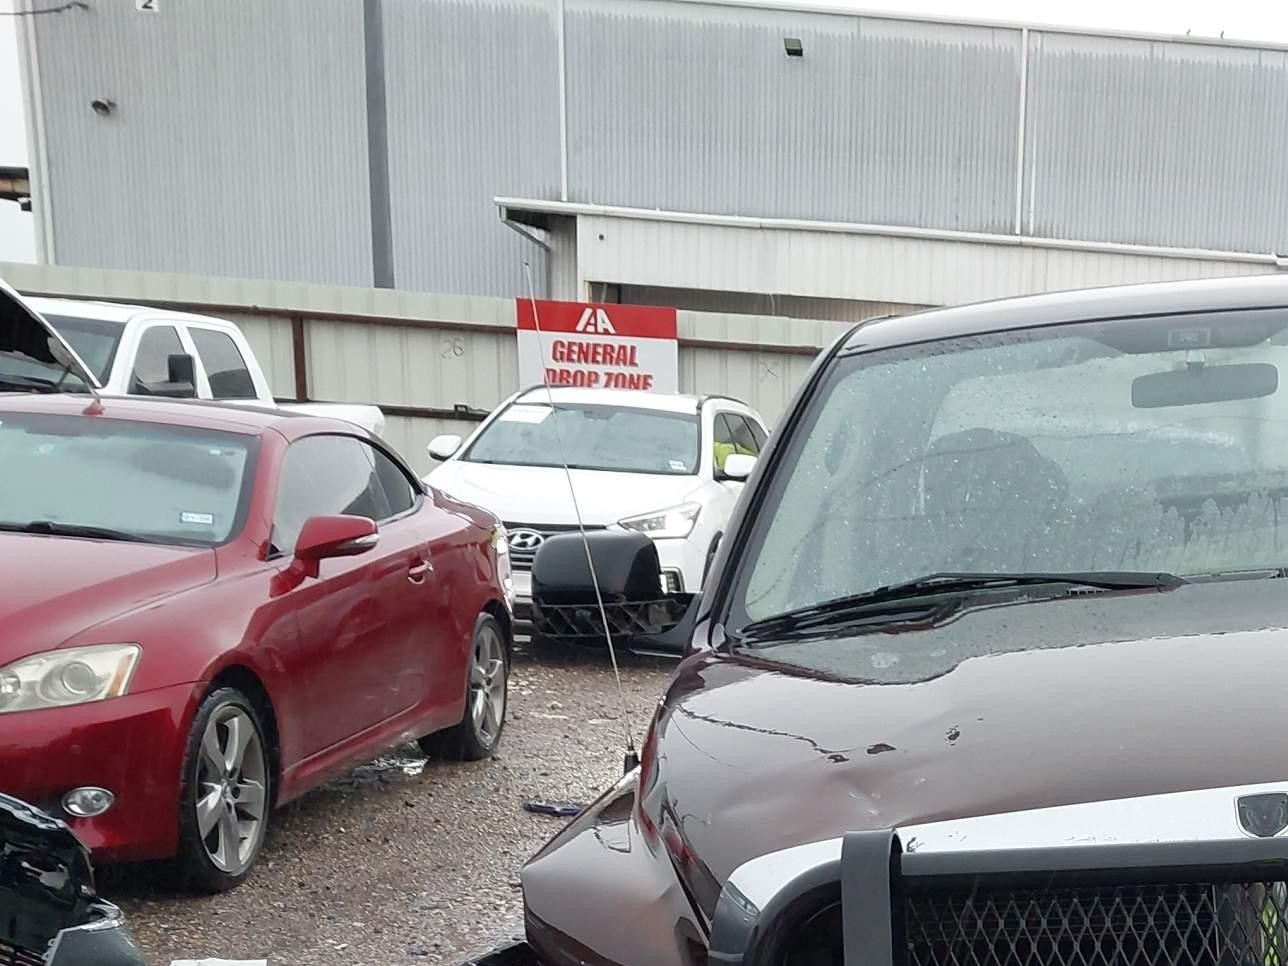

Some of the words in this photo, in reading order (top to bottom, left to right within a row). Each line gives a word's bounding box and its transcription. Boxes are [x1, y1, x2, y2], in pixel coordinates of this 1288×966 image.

[551, 340, 639, 367] GENERAL
[544, 367, 600, 388] DROP
[603, 371, 653, 390] ZONE
